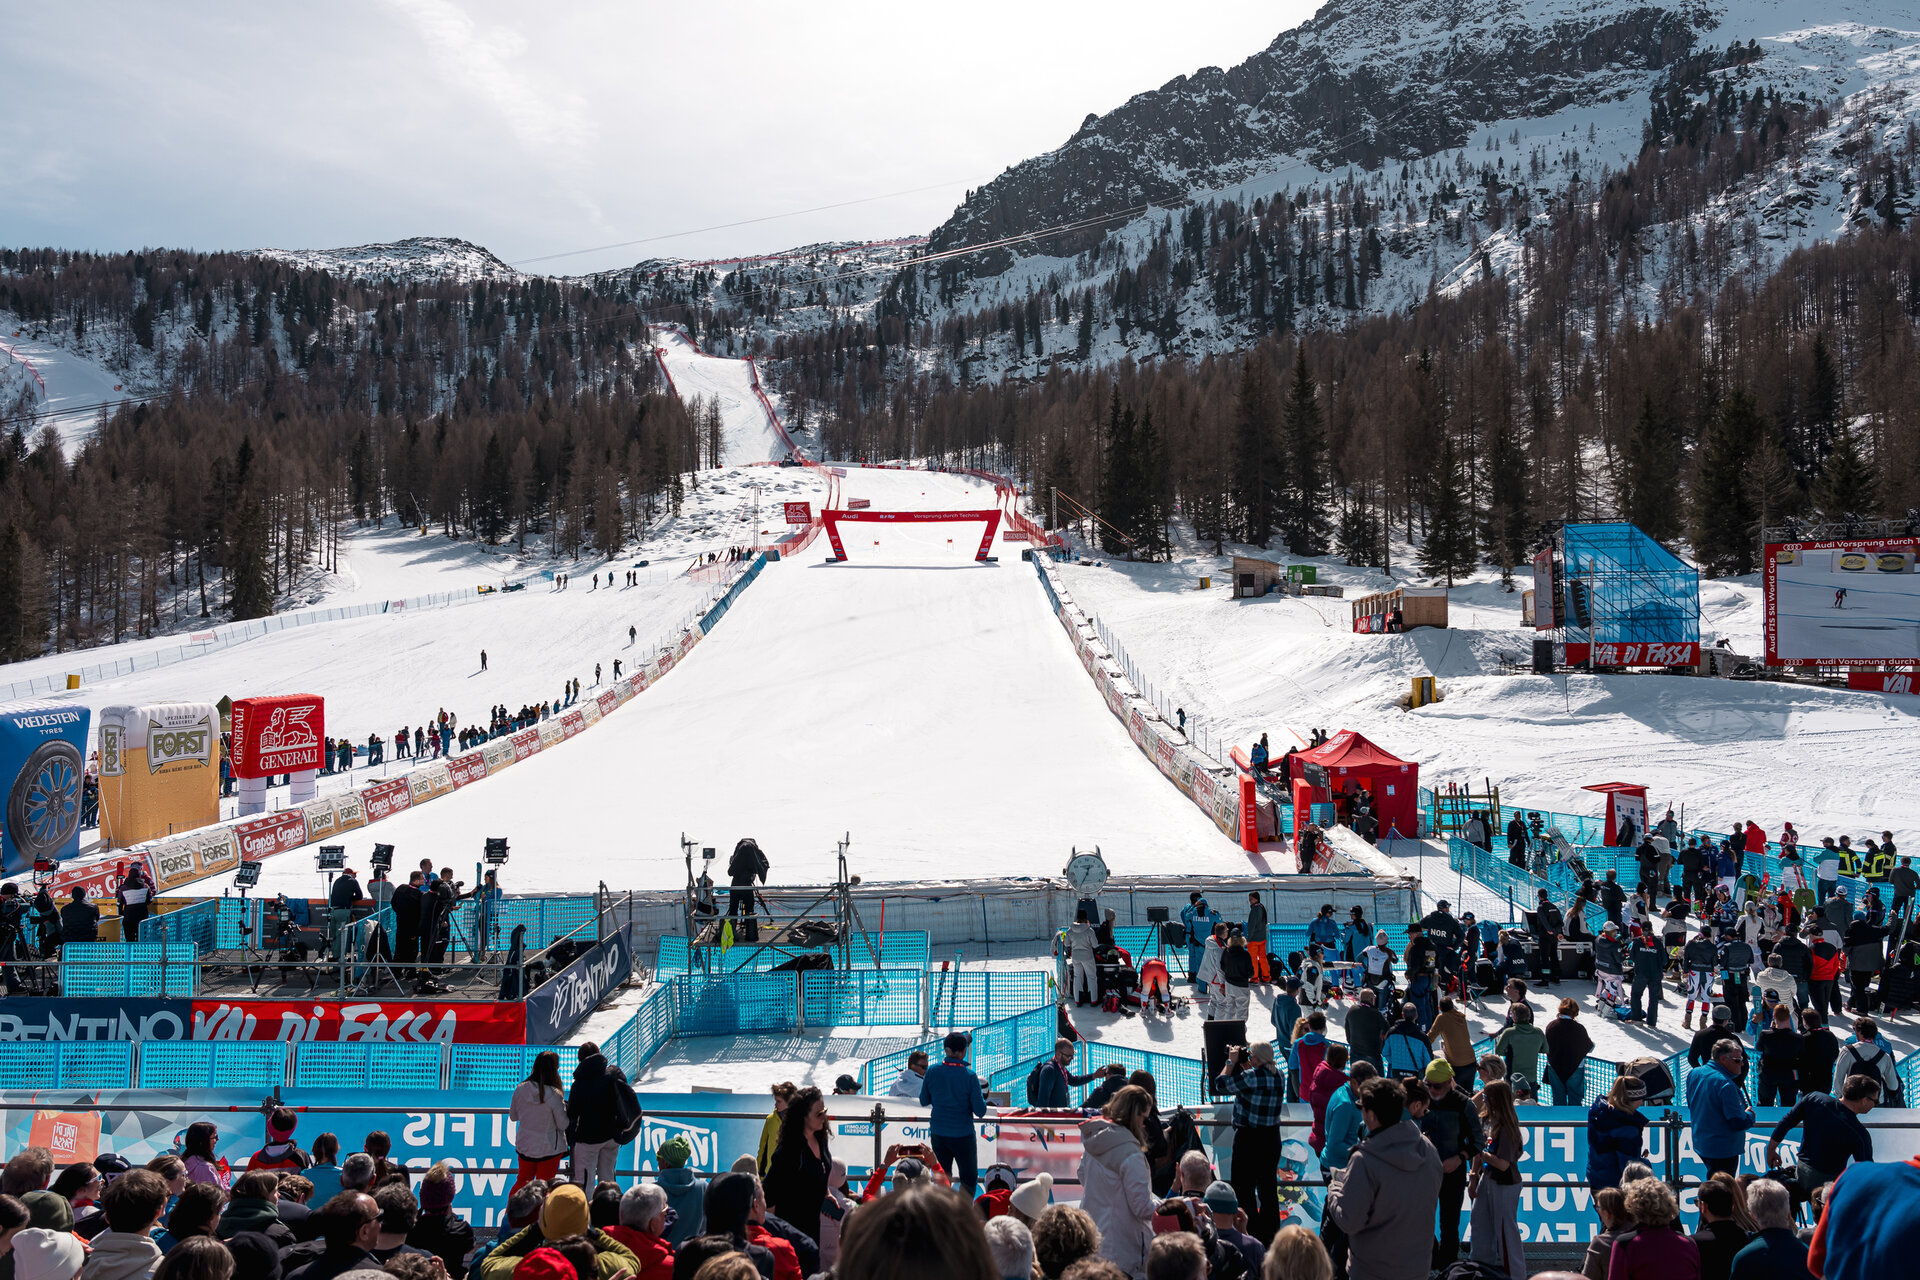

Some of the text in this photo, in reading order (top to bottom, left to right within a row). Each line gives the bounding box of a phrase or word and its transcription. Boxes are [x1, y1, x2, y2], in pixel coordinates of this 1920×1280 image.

[1837, 539, 1884, 549] Vorsprung
[1887, 537, 1914, 545] durch
[1595, 644, 1619, 664] VAL
[1645, 643, 1692, 665] FASSA
[1838, 658, 1886, 666] Vorsprung
[13, 711, 81, 729] VREDESTEIN
[40, 727, 63, 735] TYRES
[153, 729, 208, 758] FORST
[233, 707, 244, 765] GENERALI
[104, 728, 118, 773] FORST
[260, 748, 318, 770] GENERALI
[312, 812, 333, 829] FORST
[340, 804, 359, 820] FORST
[161, 853, 192, 875] FORST
[202, 842, 231, 861] FORST
[1430, 928, 1447, 938] NOR
[569, 943, 619, 1018] TRENTINO
[0, 1008, 184, 1041] RENTINO
[338, 1003, 457, 1043] FASSA
